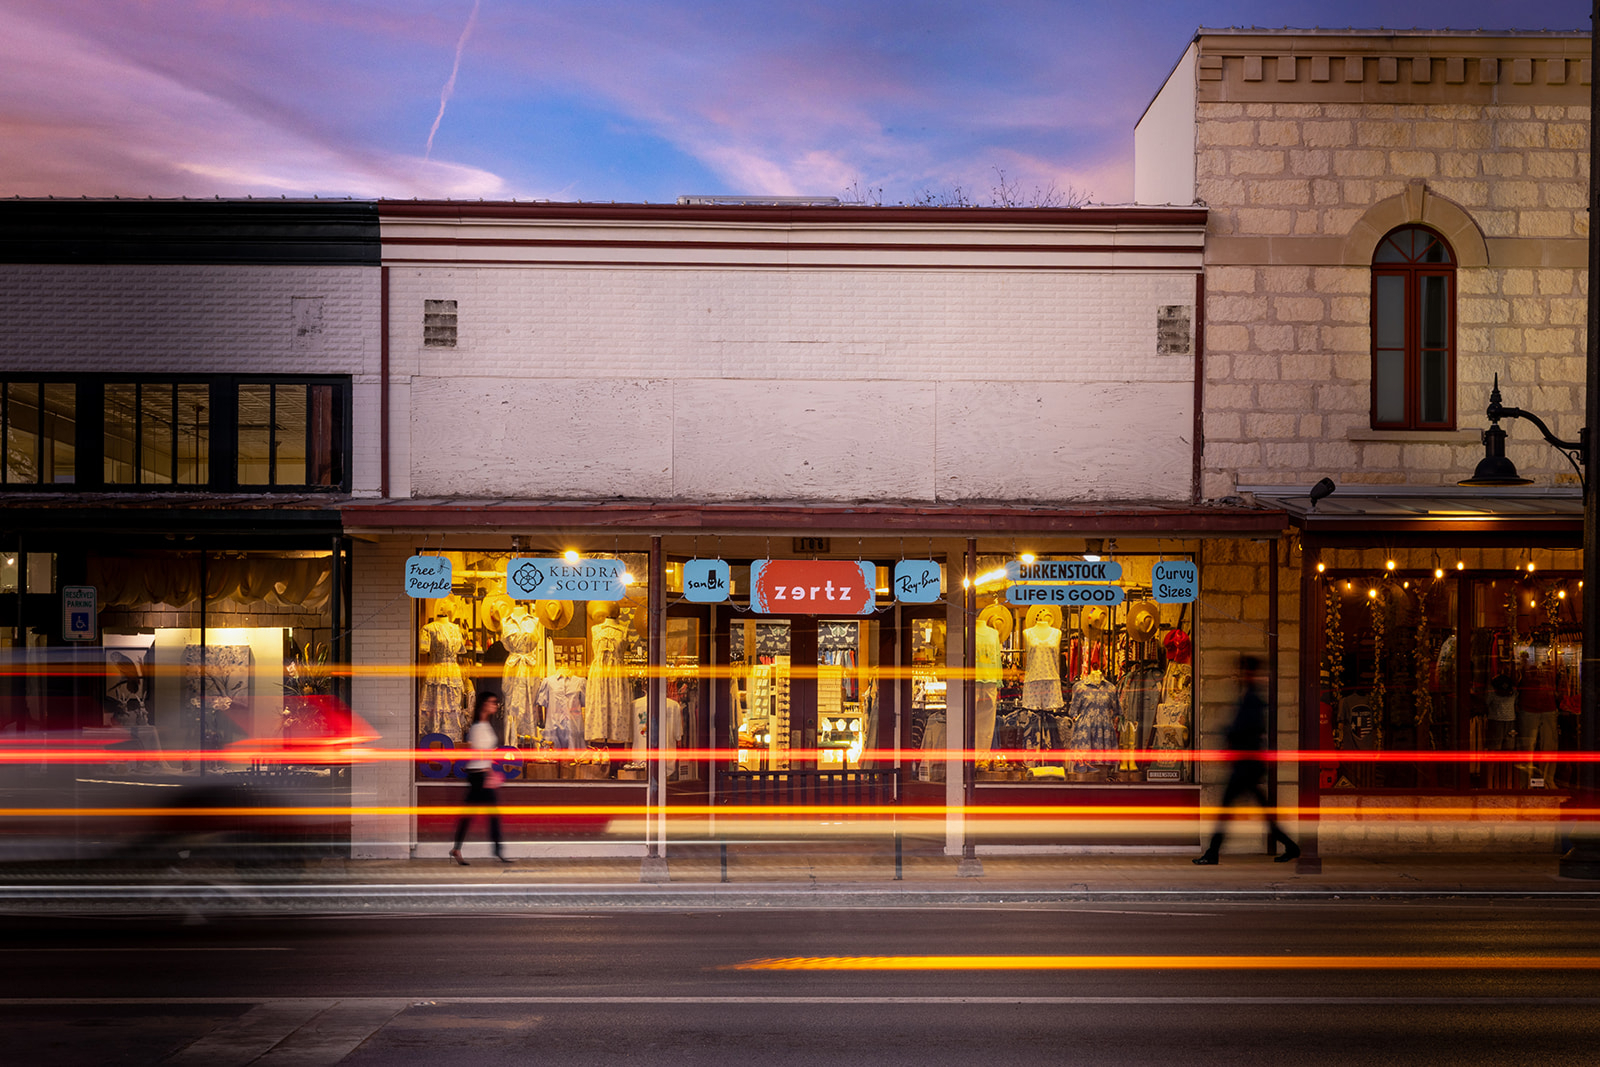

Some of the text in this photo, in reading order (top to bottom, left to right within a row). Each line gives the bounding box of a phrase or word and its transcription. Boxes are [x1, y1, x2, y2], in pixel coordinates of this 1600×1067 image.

[410, 563, 436, 576] Free
[550, 566, 619, 577] KENDRA
[1019, 564, 1106, 579] BIRKENSTOCK
[1155, 566, 1194, 583] Curvy
[409, 578, 451, 592] People
[556, 580, 613, 591] SCOTT
[896, 571, 939, 593] Ray-Ban
[1051, 589, 1064, 601] IS
[1068, 589, 1115, 601] GOOD
[1158, 583, 1192, 598] Sizes
